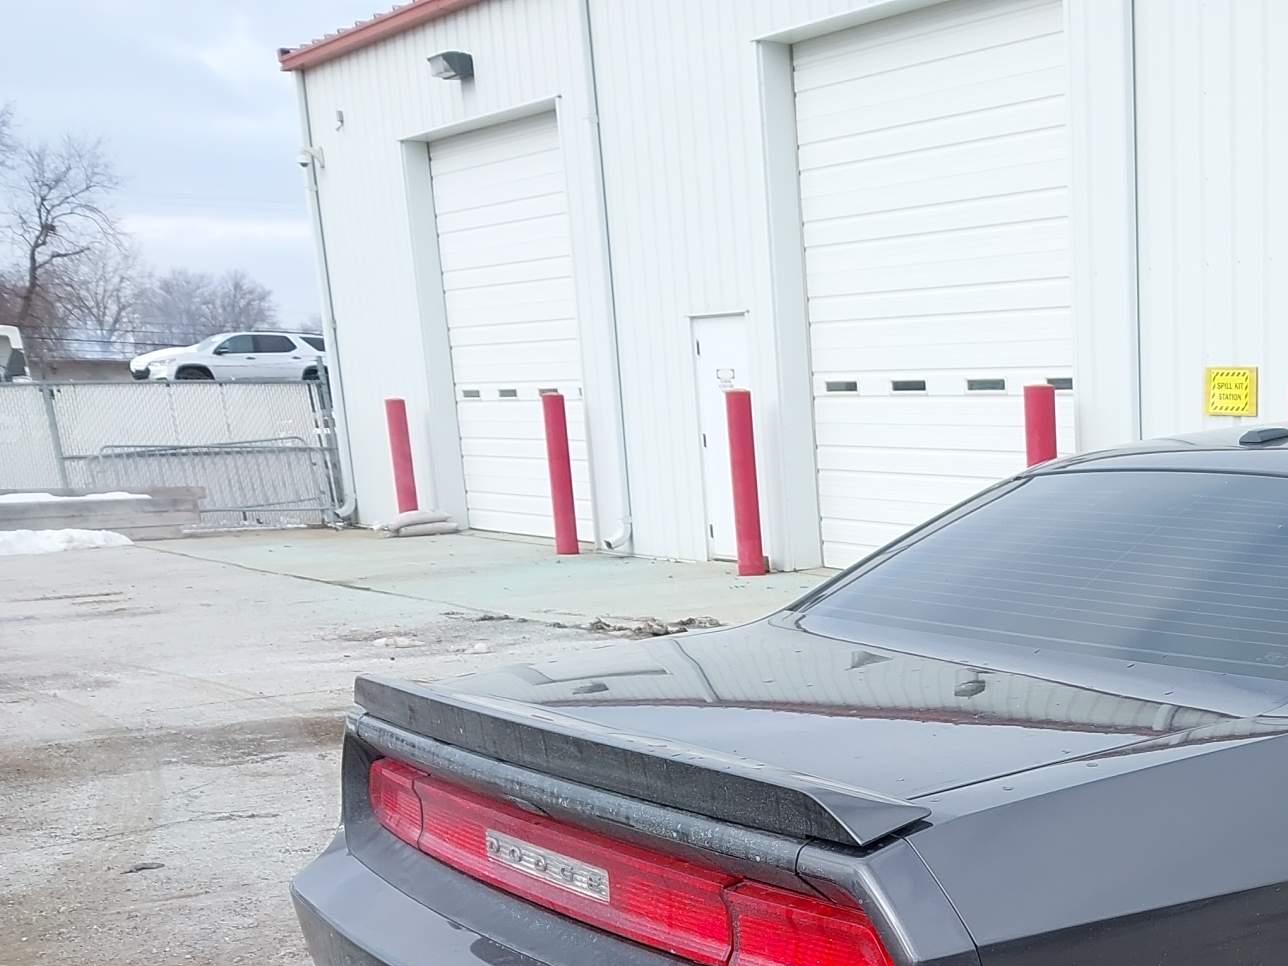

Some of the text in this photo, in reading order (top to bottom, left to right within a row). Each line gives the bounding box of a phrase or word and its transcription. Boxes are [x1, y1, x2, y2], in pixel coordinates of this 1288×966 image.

[1216, 382, 1244, 390] SPILL KIT
[1218, 393, 1242, 401] STATION
[486, 836, 602, 890] DODGE
